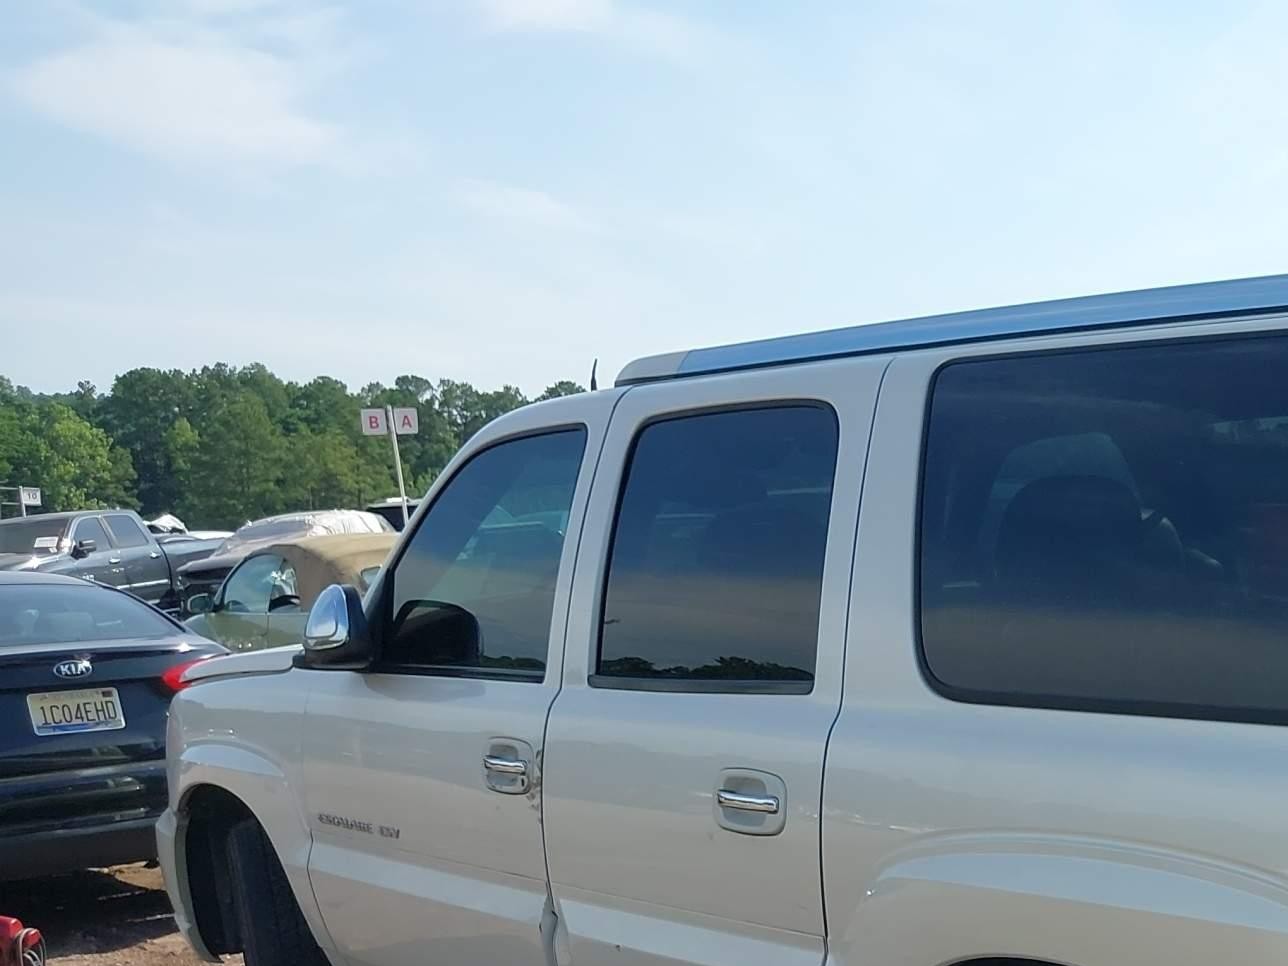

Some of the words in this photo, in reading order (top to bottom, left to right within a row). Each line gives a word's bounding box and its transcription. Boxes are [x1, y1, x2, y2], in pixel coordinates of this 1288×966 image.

[369, 415, 380, 429] B
[401, 415, 413, 429] A
[27, 491, 38, 500] 10
[60, 662, 91, 676] KIA
